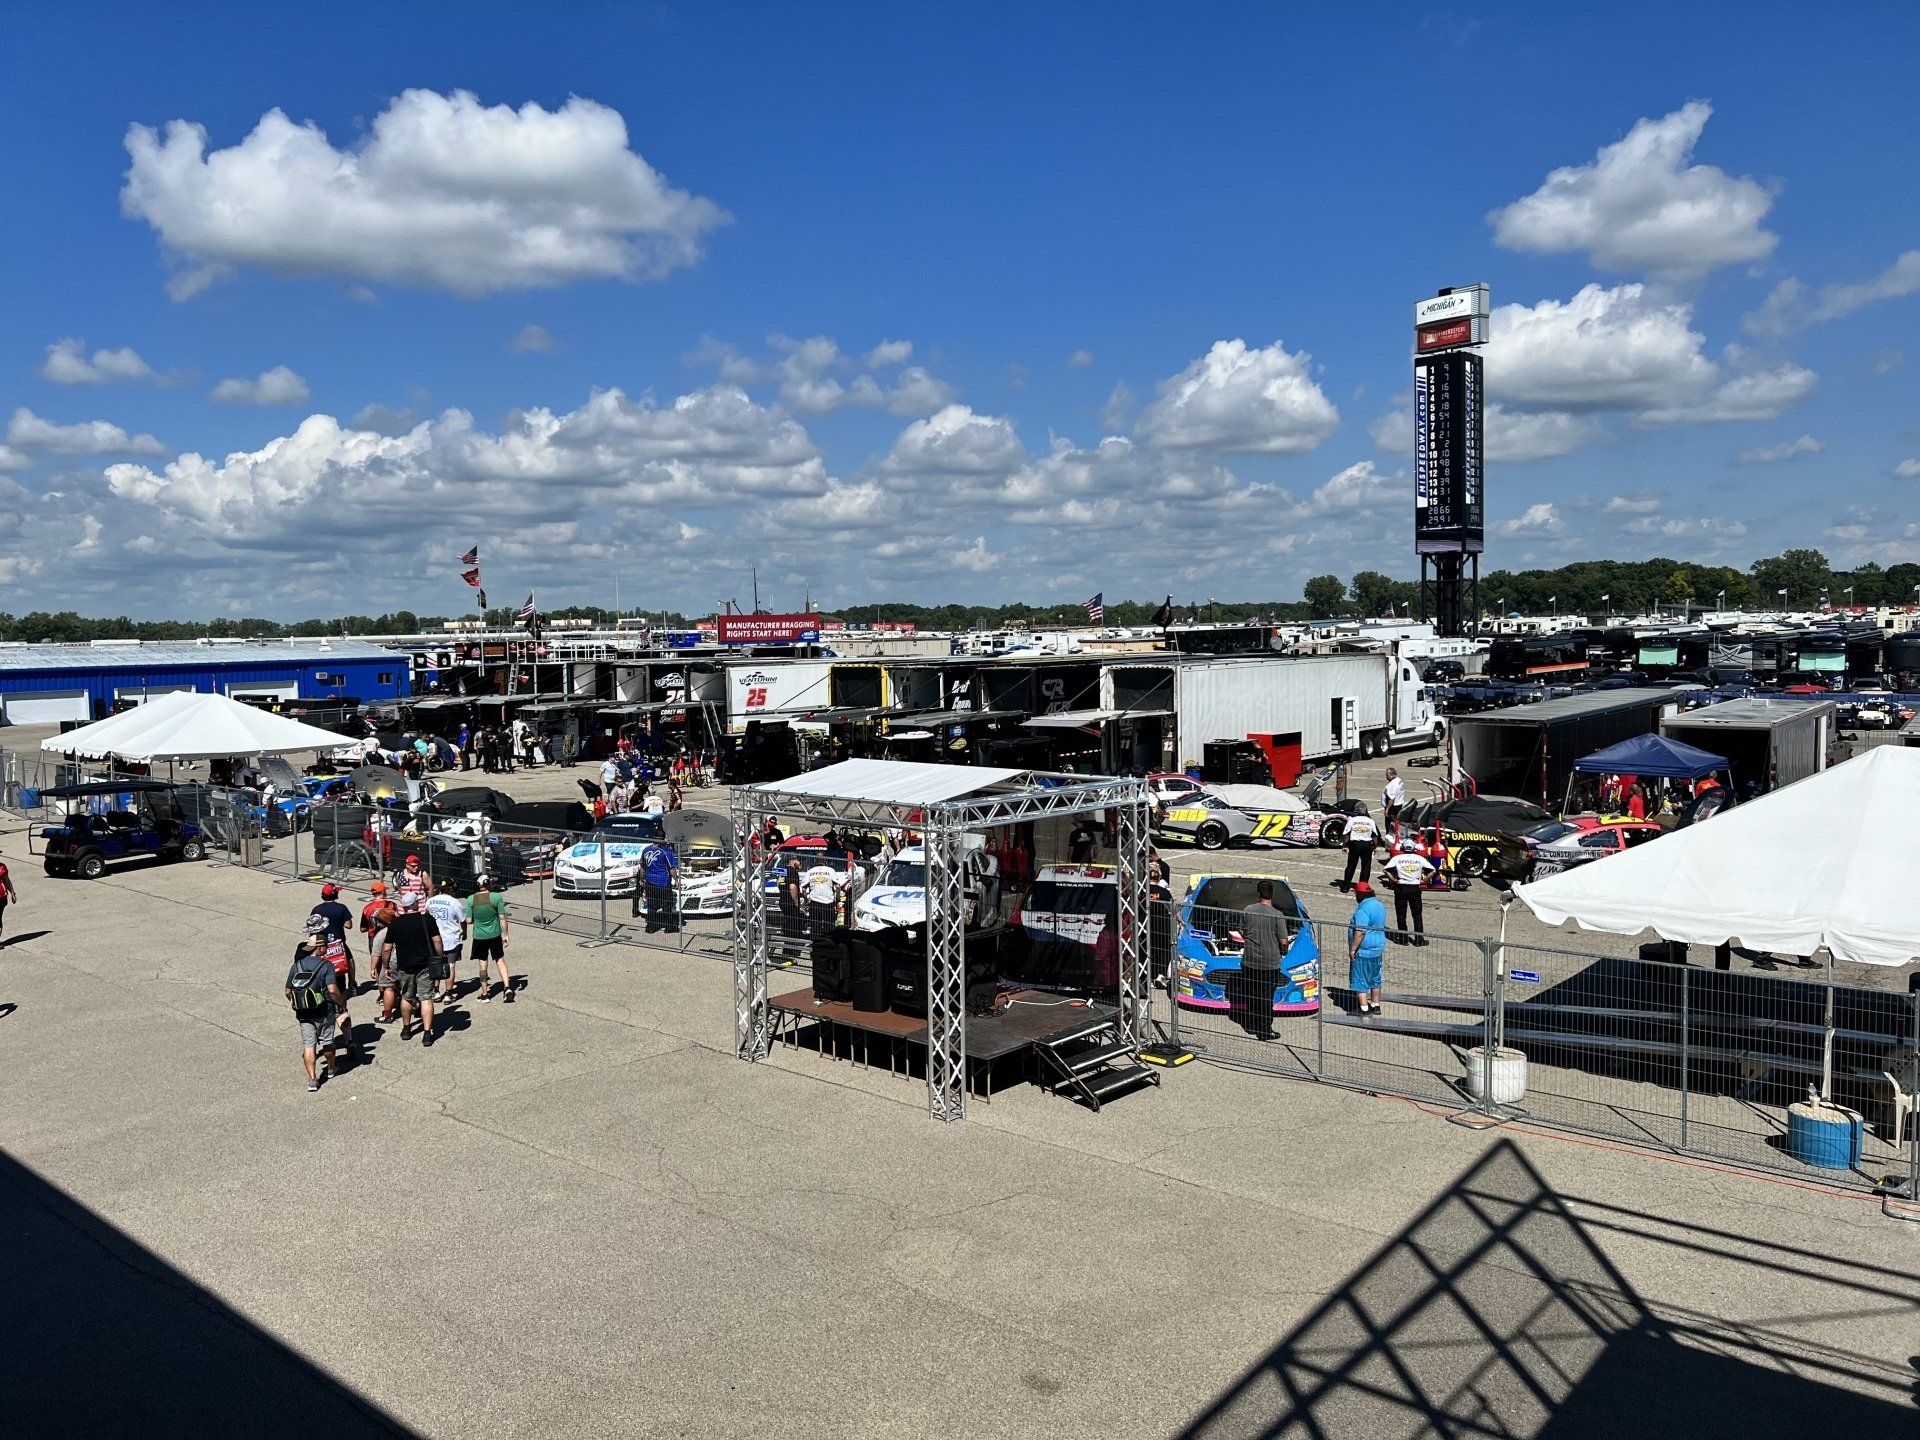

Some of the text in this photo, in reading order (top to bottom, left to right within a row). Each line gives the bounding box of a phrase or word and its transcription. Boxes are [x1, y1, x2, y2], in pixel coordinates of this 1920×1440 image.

[1426, 299, 1456, 313] MICHIGAN
[1430, 366, 1434, 374] 1
[1429, 488, 1437, 496] 14
[746, 688, 767, 706] 25
[1250, 814, 1291, 838] 72
